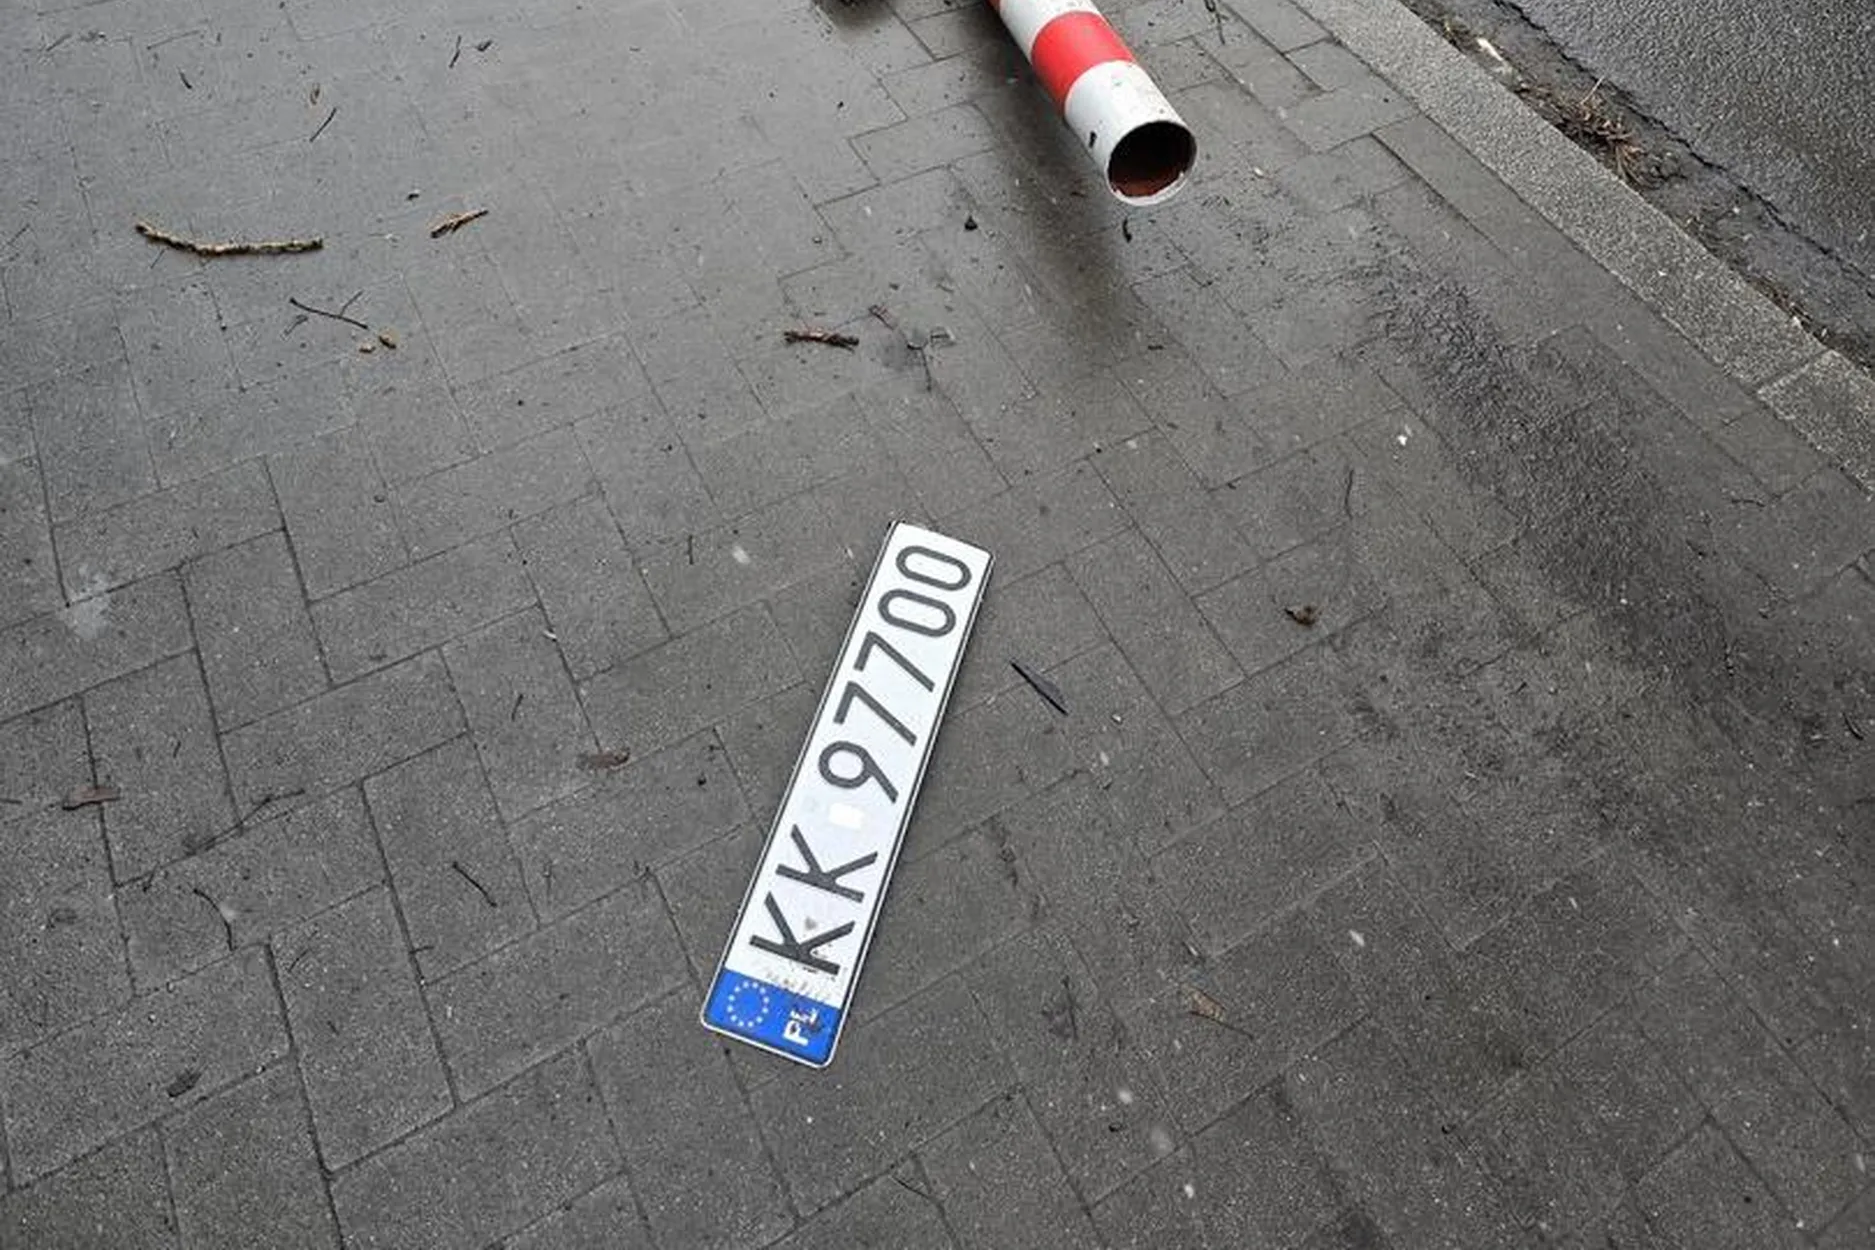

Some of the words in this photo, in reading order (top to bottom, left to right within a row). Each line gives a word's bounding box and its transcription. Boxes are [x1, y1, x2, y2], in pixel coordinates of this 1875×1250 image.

[750, 824, 878, 976] KK
[818, 545, 972, 804] 97700
[783, 1008, 819, 1046] PL
